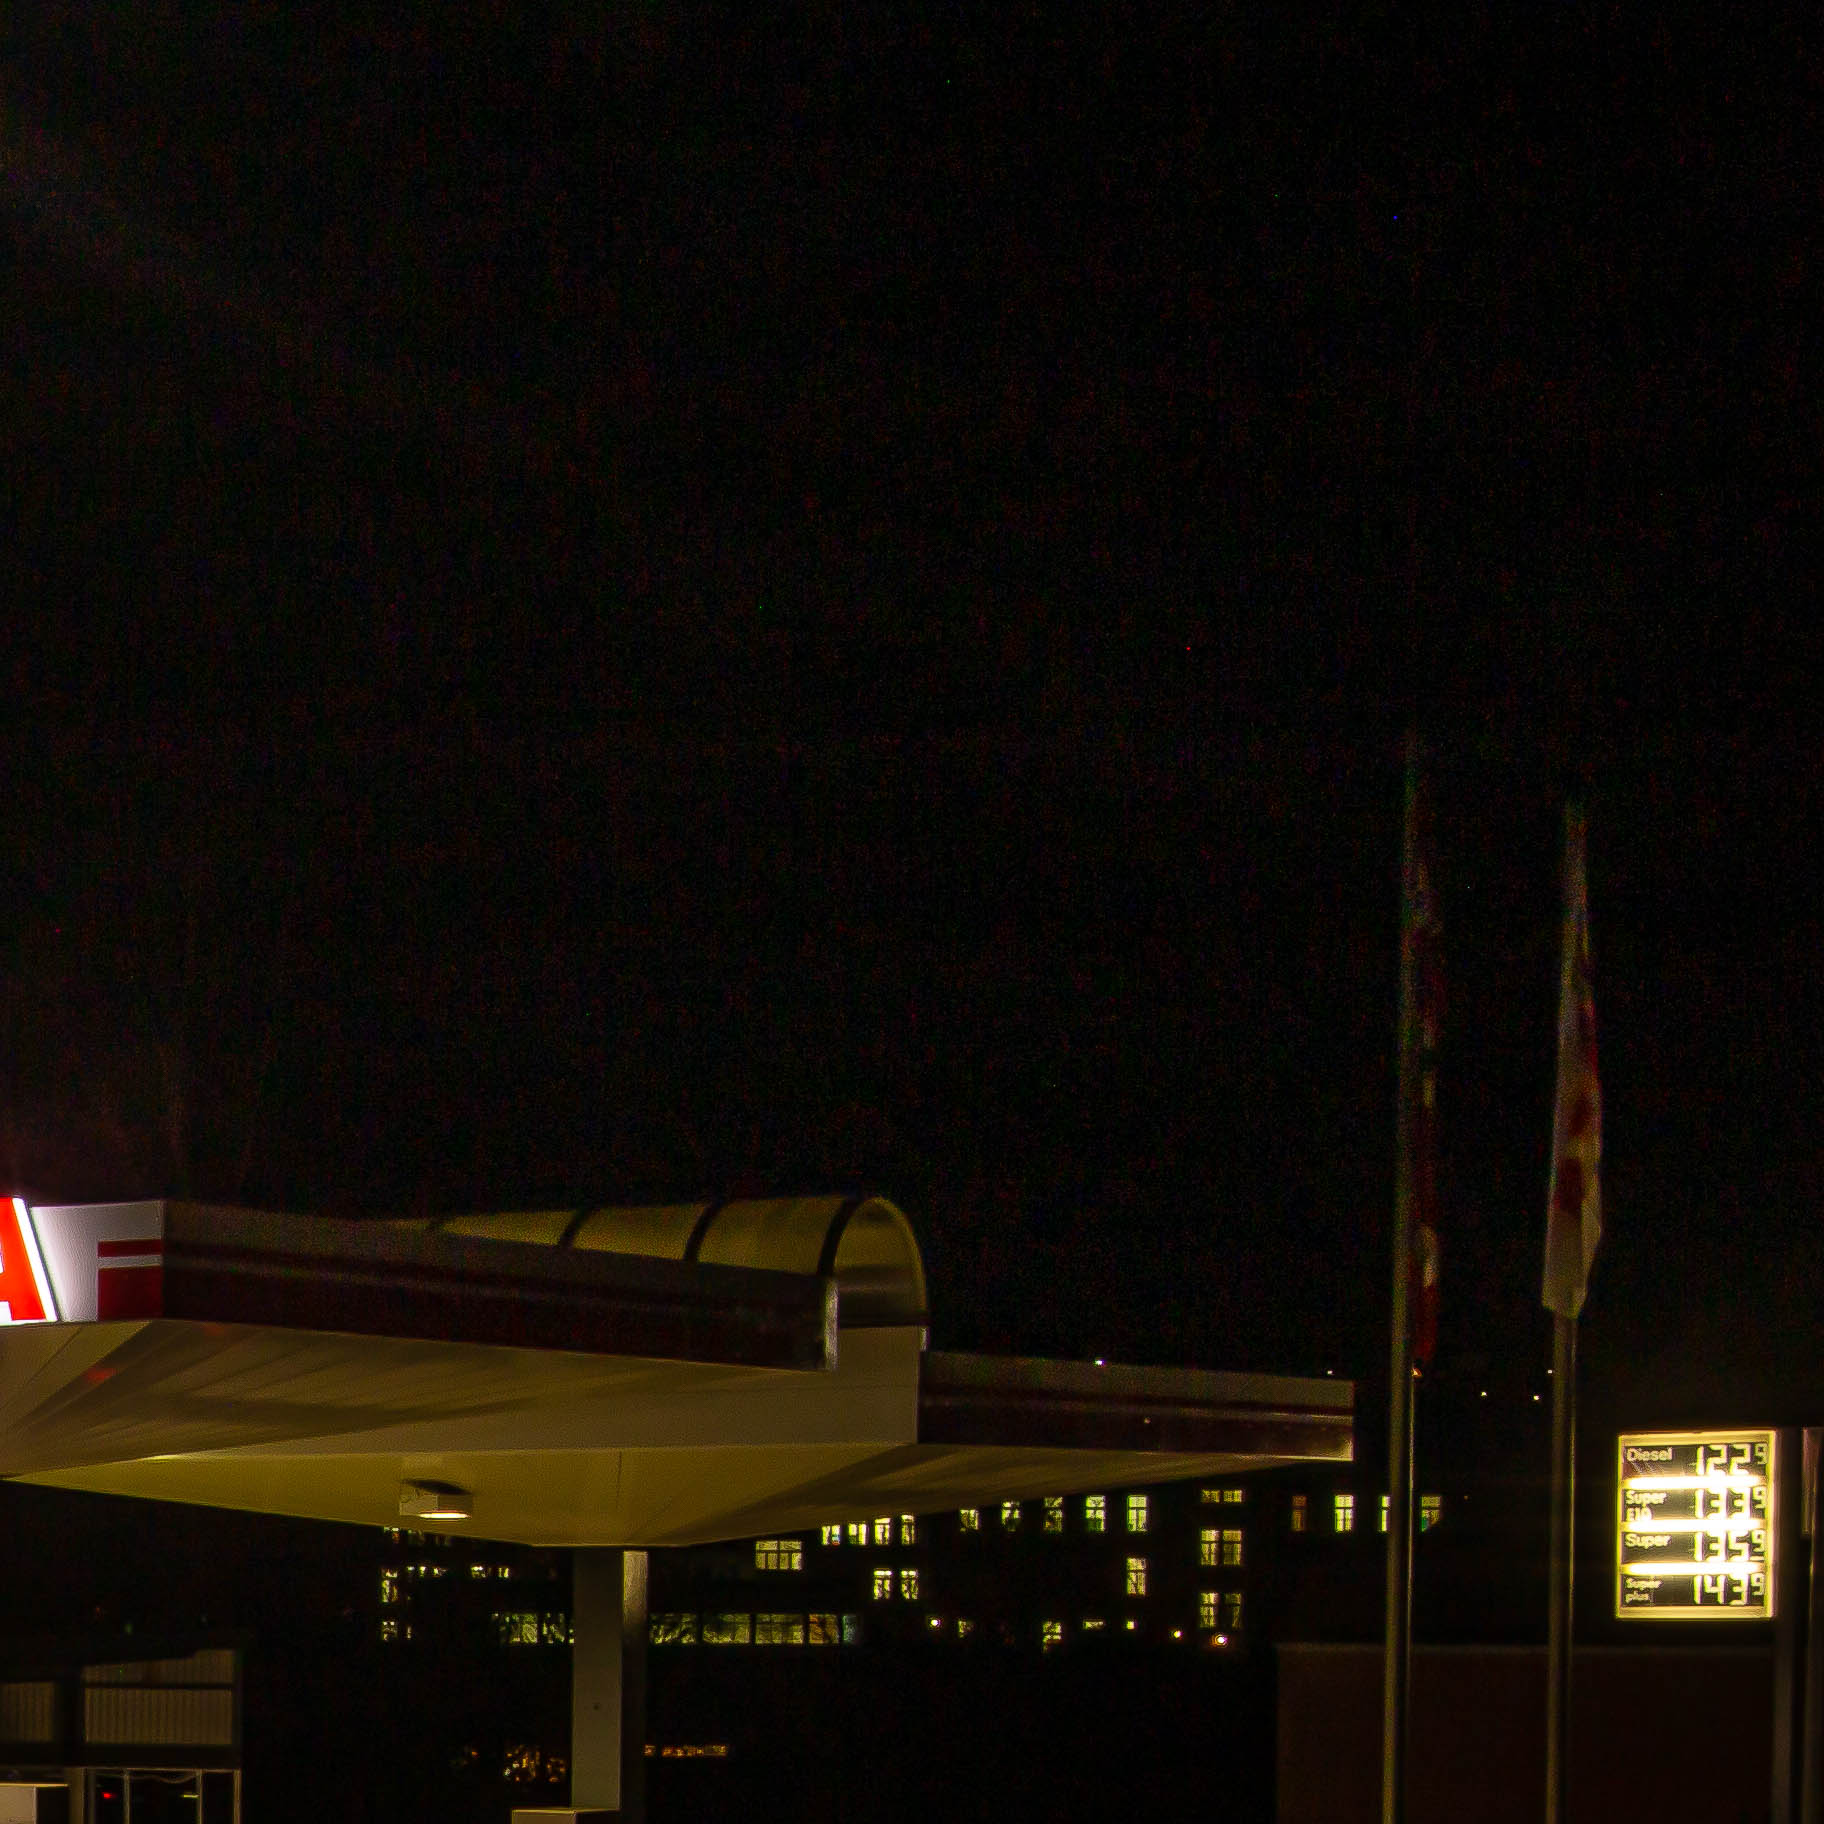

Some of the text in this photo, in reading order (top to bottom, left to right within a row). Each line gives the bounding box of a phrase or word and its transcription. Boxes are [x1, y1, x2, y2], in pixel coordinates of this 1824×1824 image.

[1626, 1447, 1673, 1462] Diesel
[1625, 1490, 1667, 1507] Super
[1625, 1533, 1672, 1549] Super
